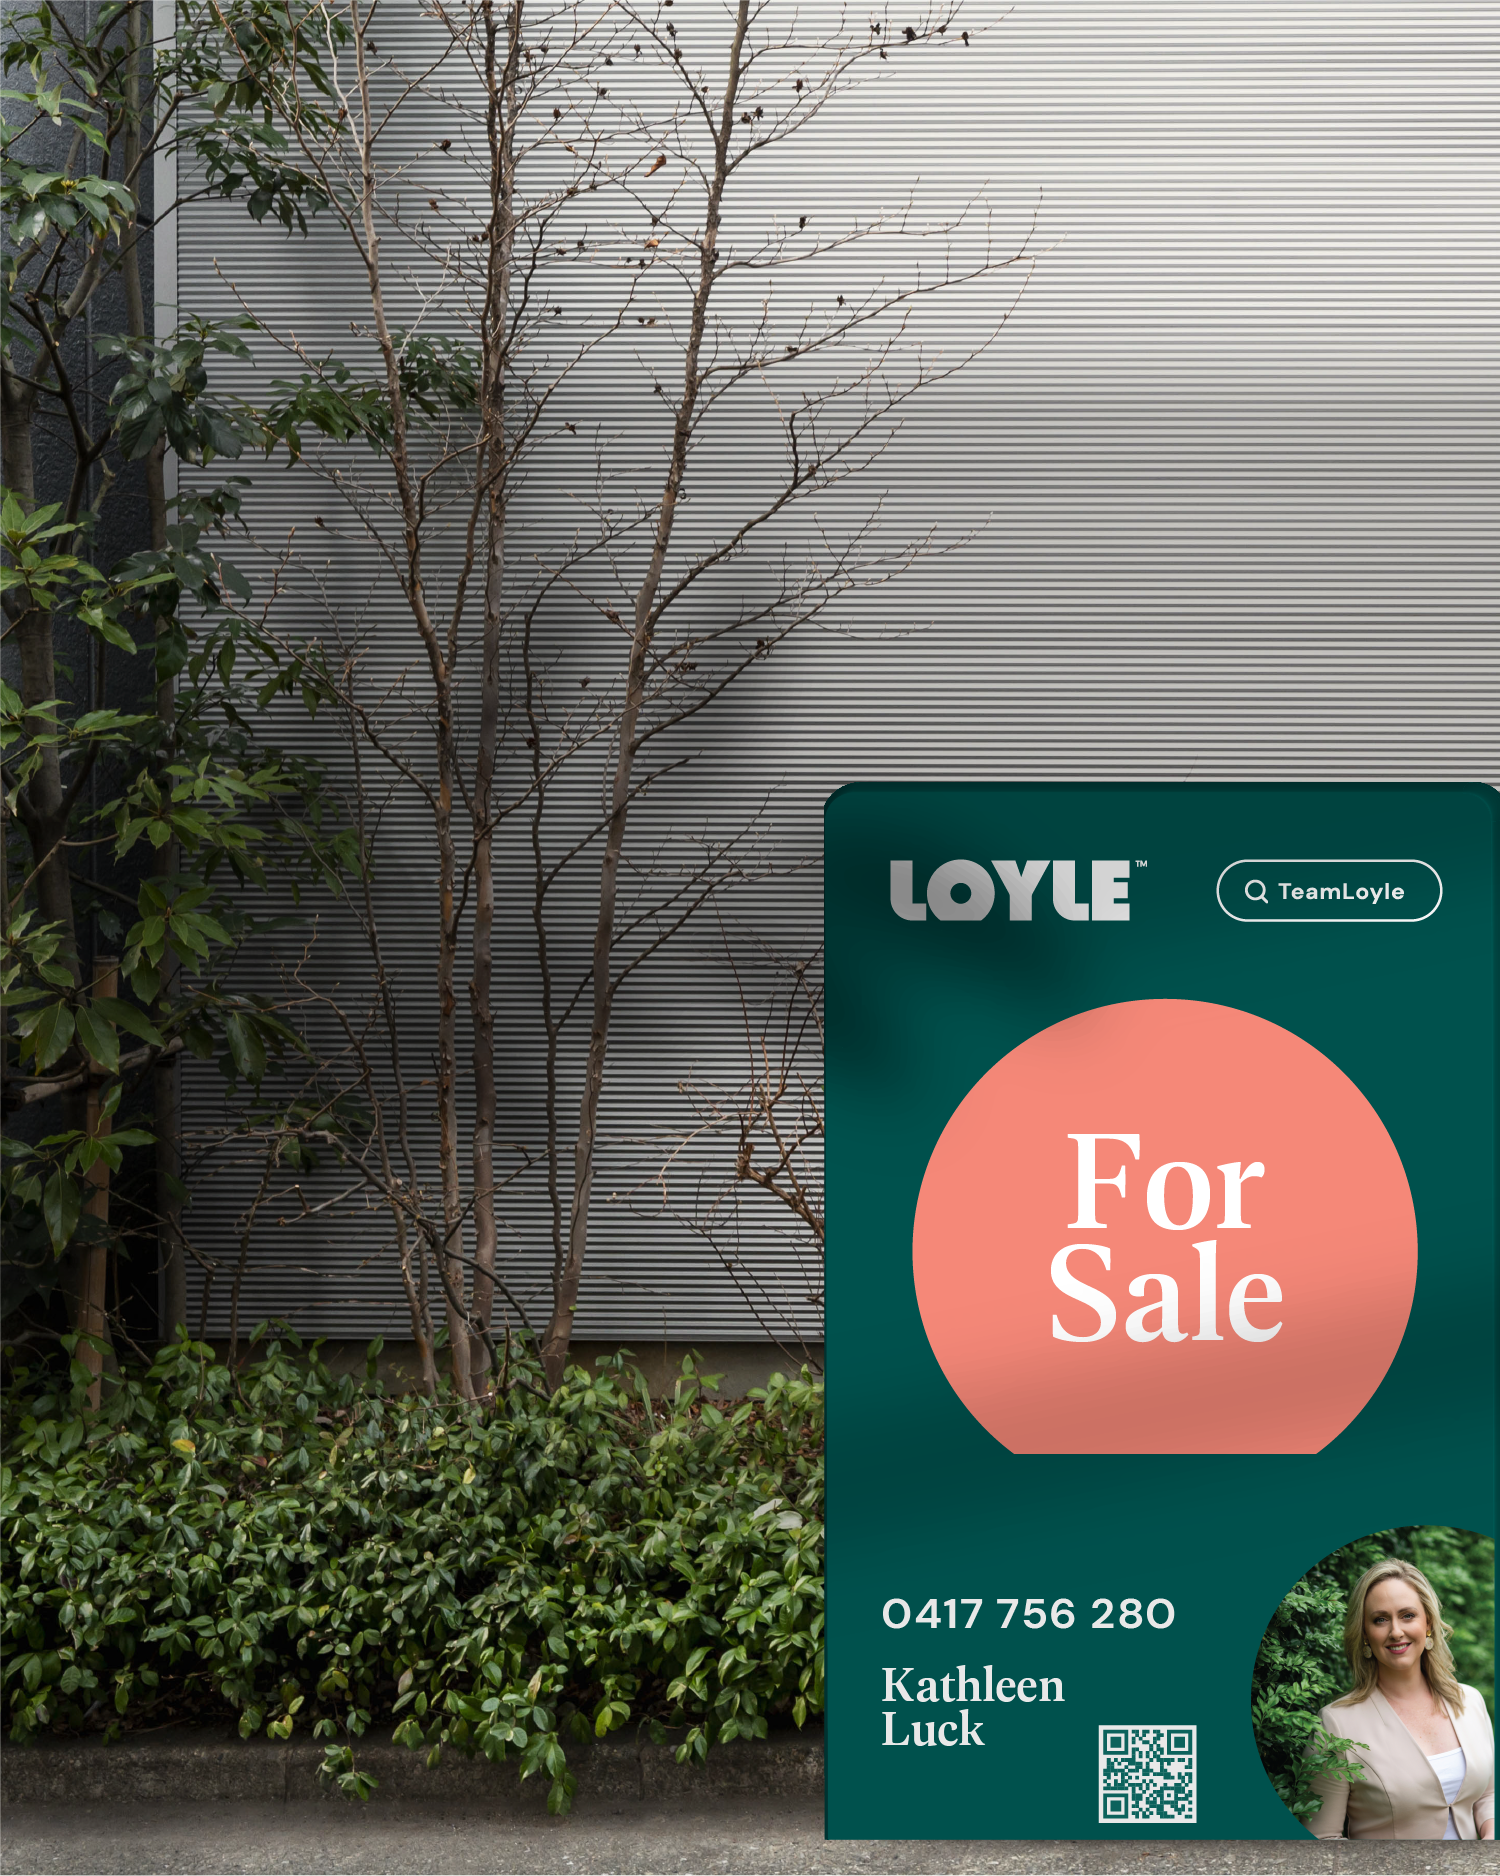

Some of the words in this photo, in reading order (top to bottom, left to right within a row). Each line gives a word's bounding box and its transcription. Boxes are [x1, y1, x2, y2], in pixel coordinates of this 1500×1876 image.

[890, 859, 1131, 922] LOYLE
[1278, 882, 1405, 905] TeamLoyle
[1067, 1133, 1266, 1231] For
[1050, 1239, 1283, 1343] Sale
[882, 1598, 983, 1630] 0417
[996, 1598, 1075, 1630] 756
[1091, 1598, 1176, 1630] 280
[882, 1664, 1066, 1703] Kathleen
[882, 1708, 986, 1747] Luck
